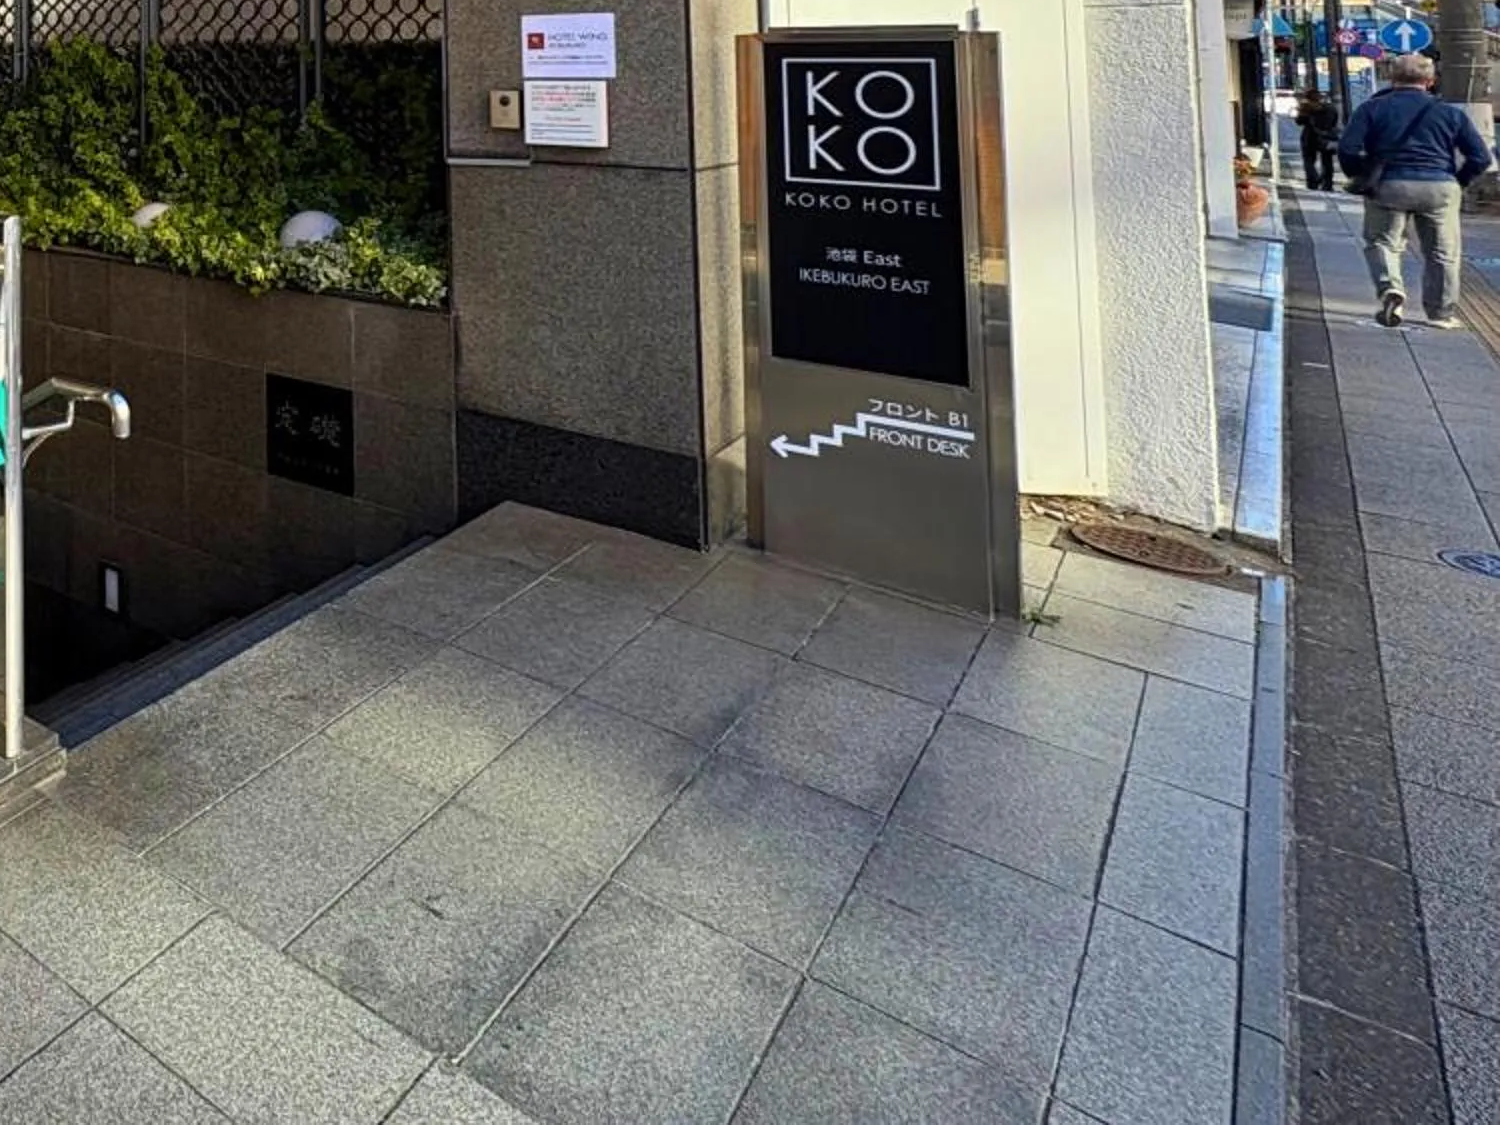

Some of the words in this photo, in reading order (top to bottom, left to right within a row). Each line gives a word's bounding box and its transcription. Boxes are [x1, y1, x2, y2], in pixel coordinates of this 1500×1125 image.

[805, 70, 915, 120] KO
[807, 124, 917, 175] KO
[784, 191, 851, 210] KOKO
[862, 198, 943, 219] HOTEL
[863, 249, 903, 268] East
[798, 267, 887, 291] IKEBUKURO
[891, 277, 931, 295] EAST
[868, 398, 939, 422] フロント
[948, 410, 969, 428] B1
[869, 426, 923, 450] FRONT
[927, 437, 971, 460] DESK
